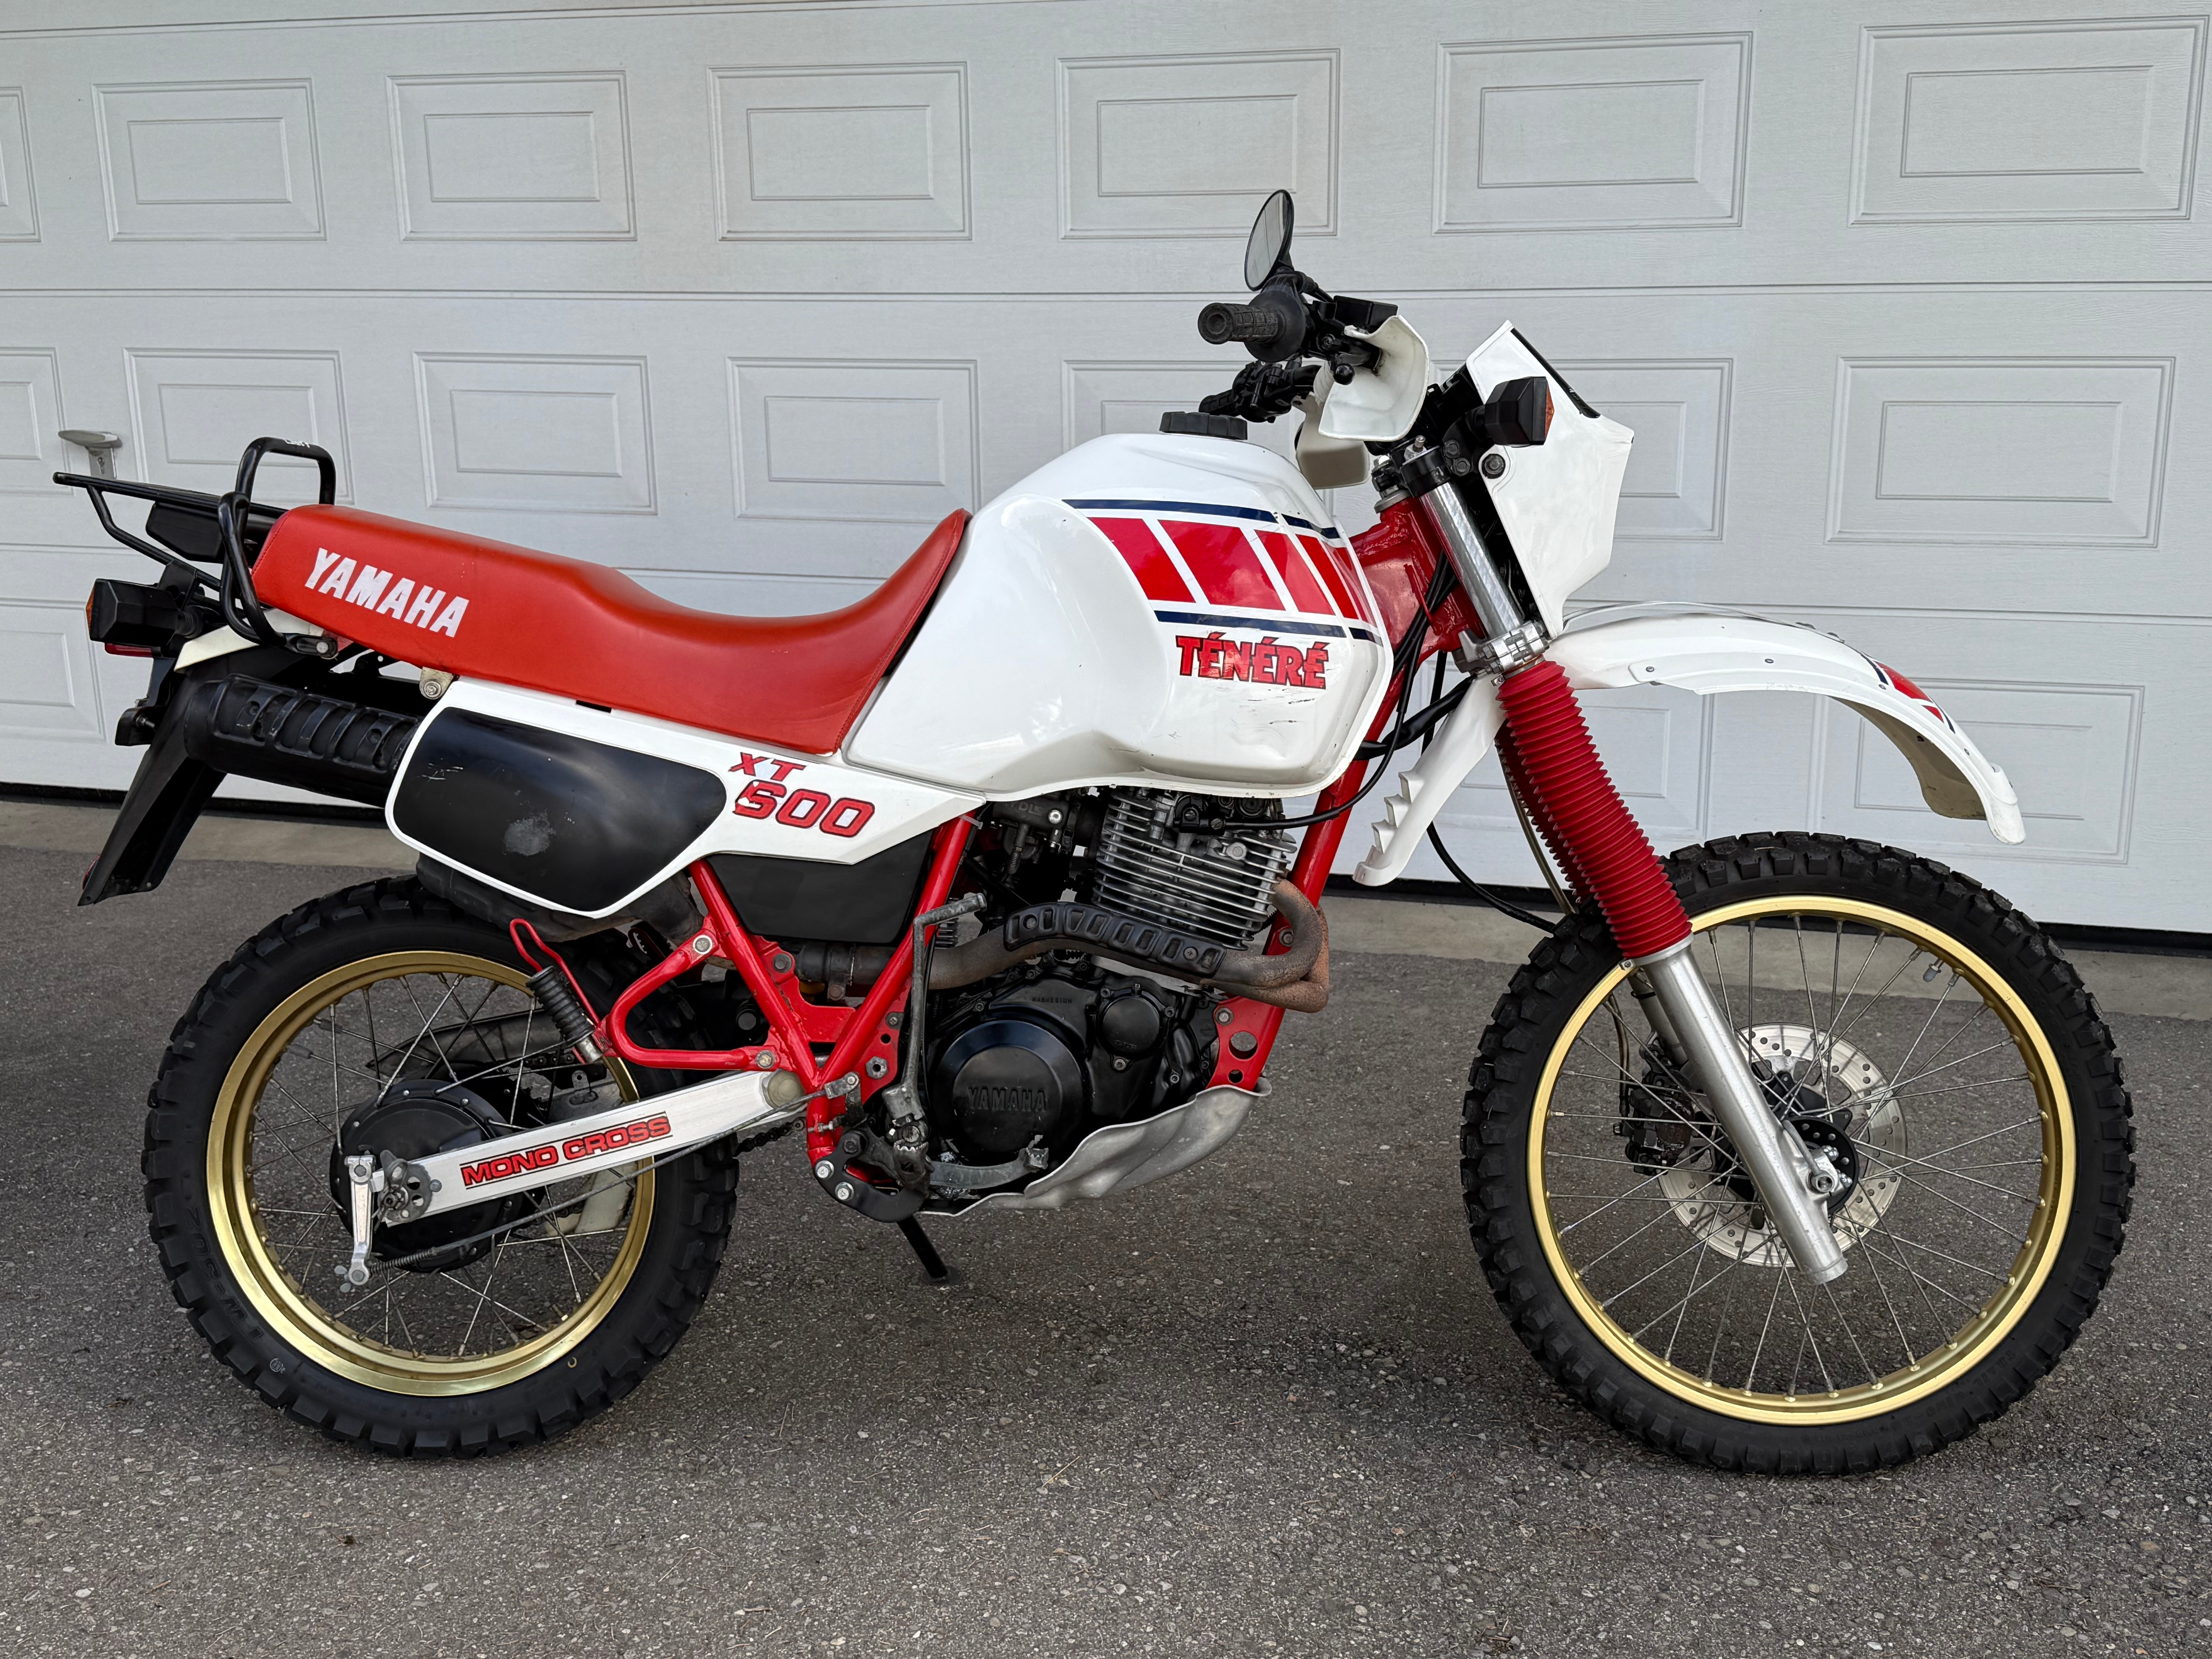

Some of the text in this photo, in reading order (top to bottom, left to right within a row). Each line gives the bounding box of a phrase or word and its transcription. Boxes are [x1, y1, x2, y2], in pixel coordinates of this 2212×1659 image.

[304, 547, 469, 638] YAMAHA
[1175, 632, 1330, 689] TÉNÉRÉ
[728, 752, 807, 782] XT
[968, 1087, 1046, 1111] YAMAHA
[460, 1116, 671, 1186] MONO CROSS
[183, 1206, 264, 1347] TW-302
